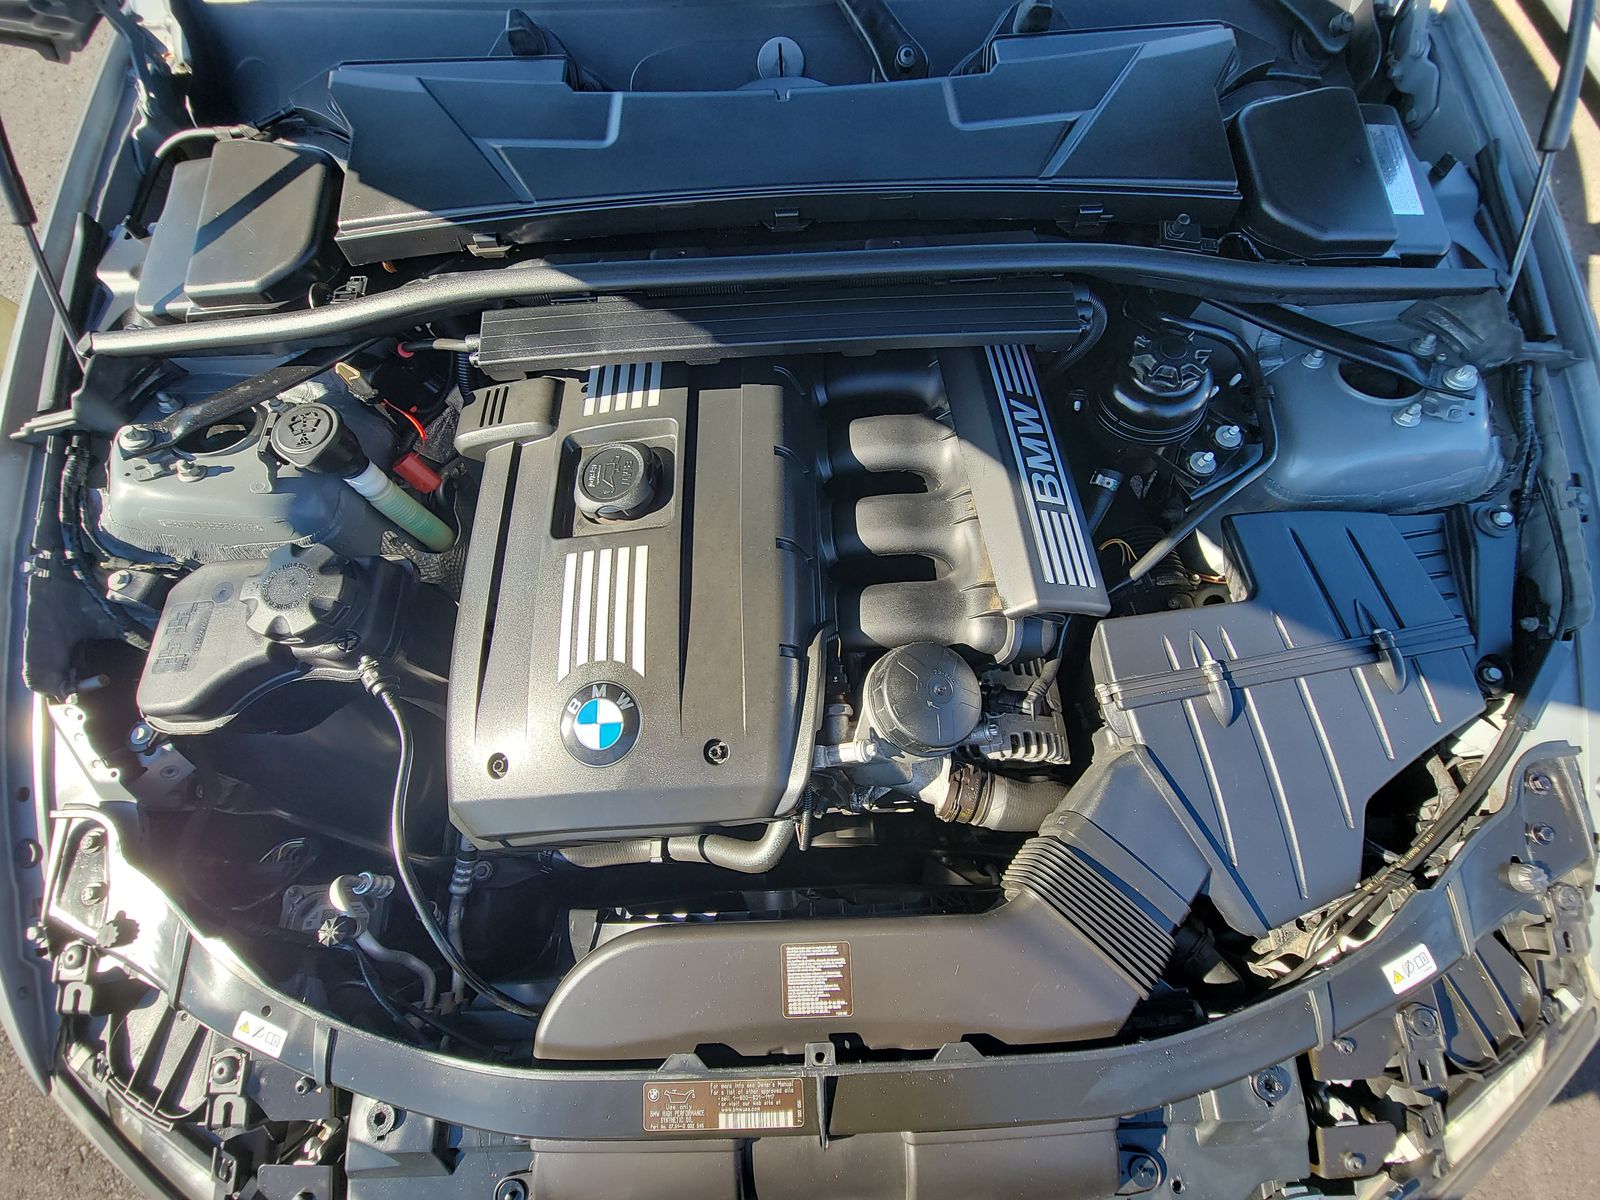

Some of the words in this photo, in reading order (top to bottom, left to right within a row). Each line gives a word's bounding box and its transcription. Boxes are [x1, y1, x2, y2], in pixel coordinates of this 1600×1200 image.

[1009, 399, 1066, 506] BMW
[567, 684, 635, 715] BMW
[777, 1080, 794, 1088] Manual
[680, 1103, 693, 1111] only
[674, 1109, 705, 1117] PERFORMANCE
